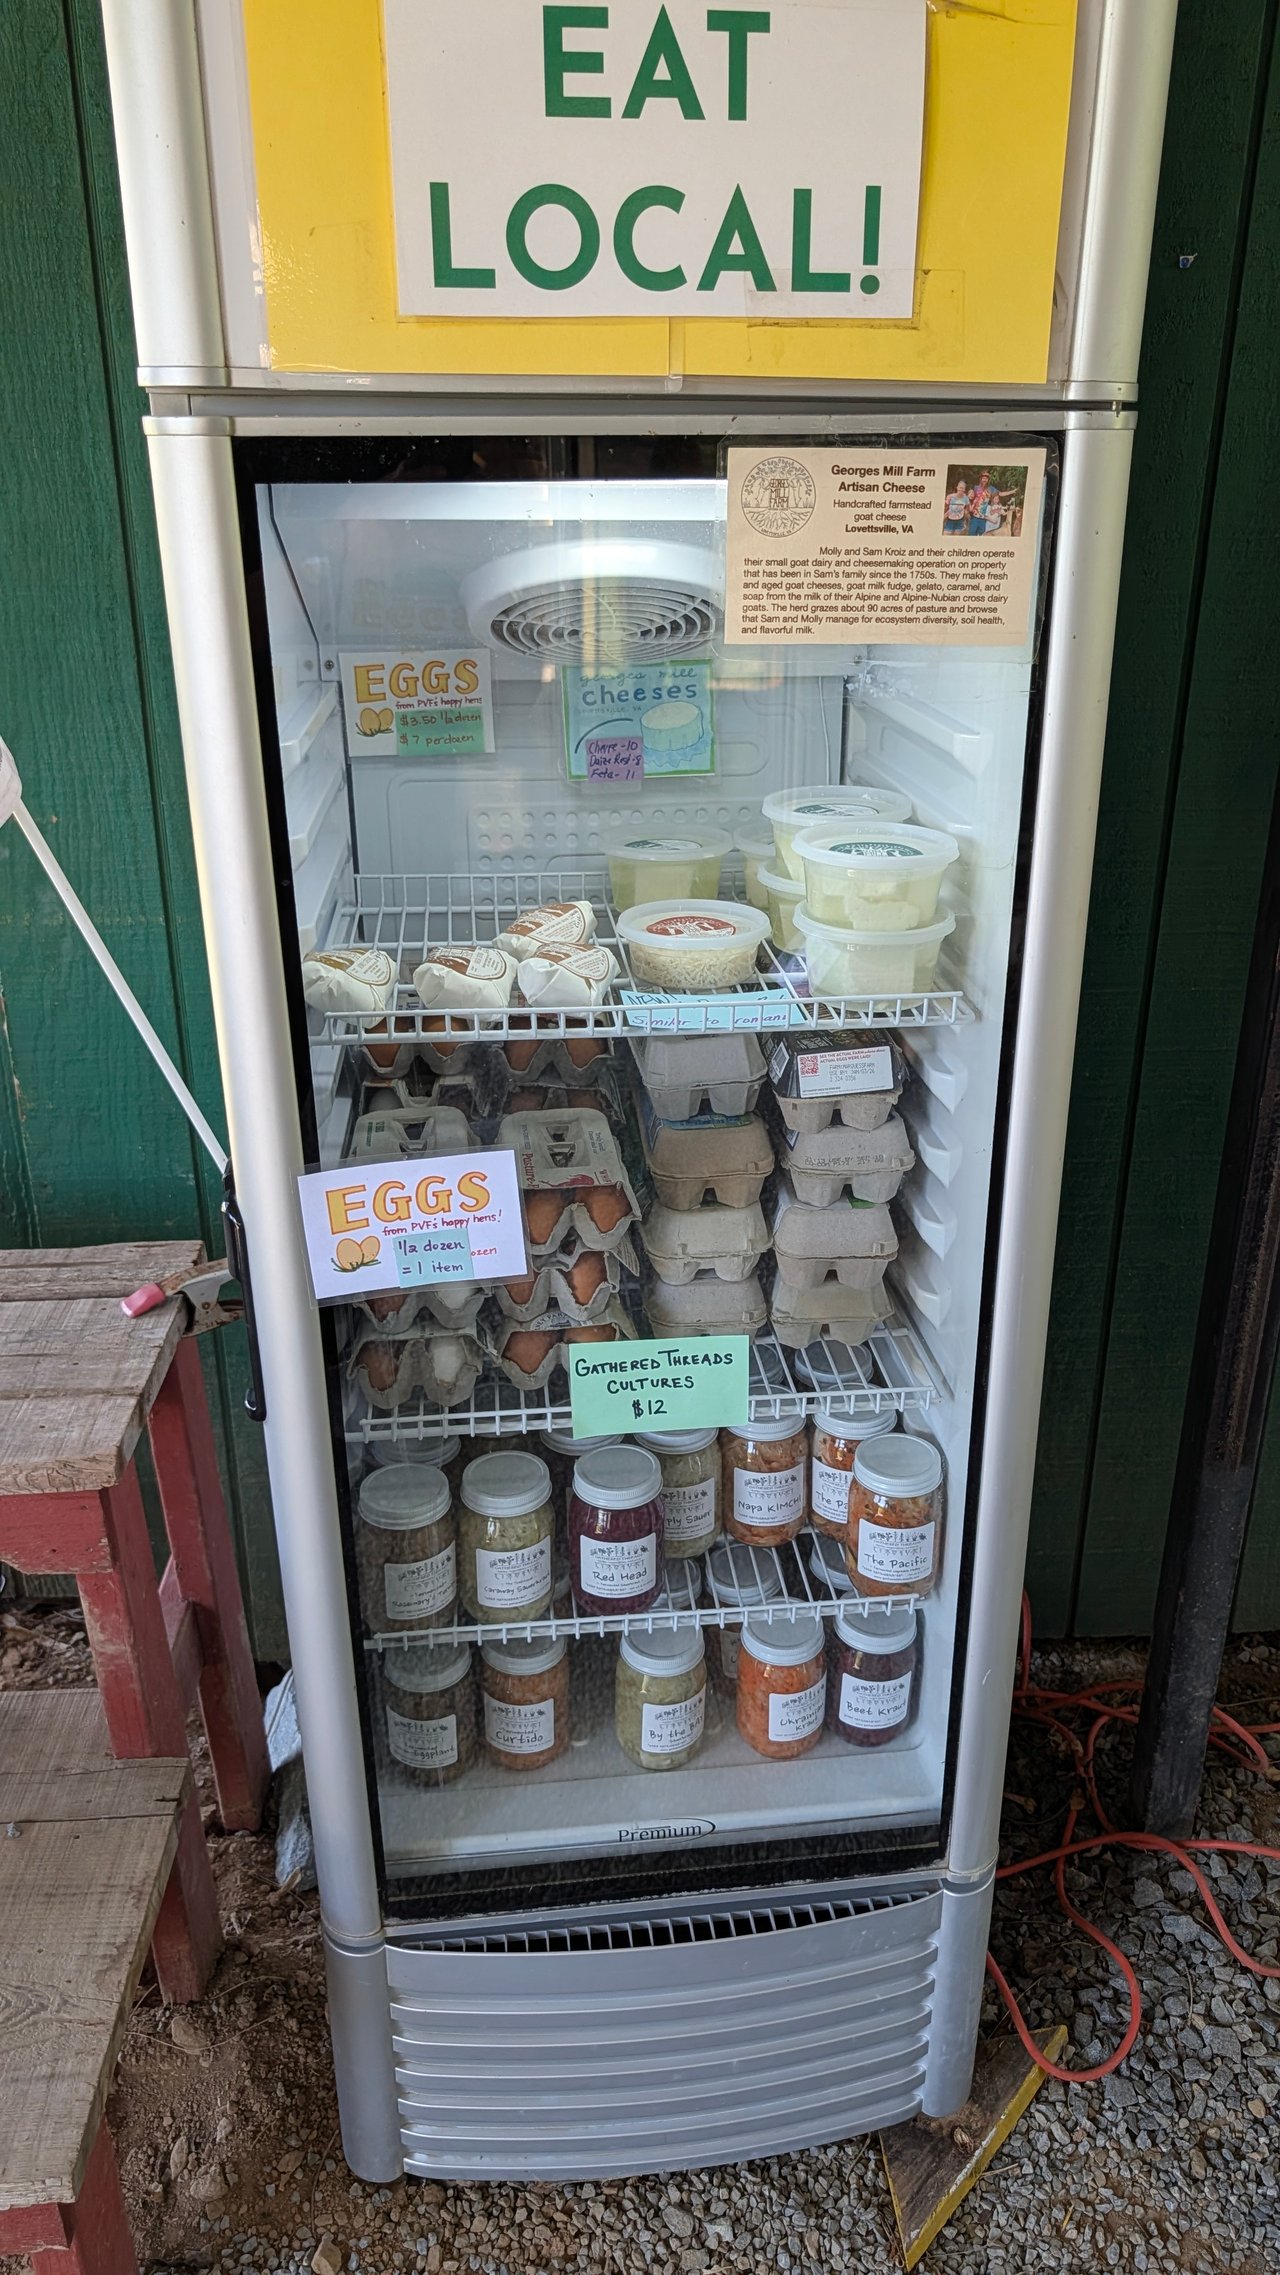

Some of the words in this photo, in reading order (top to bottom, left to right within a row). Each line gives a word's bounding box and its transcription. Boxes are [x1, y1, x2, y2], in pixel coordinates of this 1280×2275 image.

[543, 4, 770, 121] EAT
[429, 182, 882, 295] LOCAL!
[831, 465, 879, 478] Georges
[883, 466, 903, 476] Mill
[906, 466, 935, 477] Farm
[838, 482, 879, 492] Artisan
[882, 482, 925, 493] Cheese
[833, 499, 886, 508] Handcrafted
[889, 500, 932, 509] farmstead
[854, 513, 873, 522] goat
[876, 513, 906, 521] cheese
[845, 524, 899, 534] Lovettsville,
[901, 525, 914, 533] VA
[820, 547, 841, 557] Molly
[863, 548, 882, 556] Sam
[885, 548, 906, 556] Kroiz
[908, 548, 924, 556] and
[927, 549, 945, 557] their
[947, 549, 980, 557] children
[983, 550, 1015, 559] operate
[744, 558, 763, 566] their
[765, 558, 787, 567] small
[790, 559, 809, 568] goat
[812, 559, 832, 569] dairy
[835, 559, 851, 567] and
[853, 559, 913, 569] cheesemaking
[916, 560, 955, 569] operation
[971, 561, 1006, 570] property
[744, 569, 760, 577] that
[762, 569, 777, 578] has
[780, 570, 801, 578] been
[804, 570, 811, 578] in
[814, 569, 839, 578] Sam's
[842, 570, 867, 580] family
[869, 570, 891, 578] since
[894, 571, 907, 579] the
[910, 571, 937, 579] 1750s.
[940, 571, 960, 581] They
[963, 572, 985, 580] make
[988, 572, 1008, 580] fresh
[743, 581, 759, 589] and
[762, 581, 782, 591] aged
[785, 581, 804, 591] goat
[807, 581, 844, 591] cheeses,
[847, 582, 865, 591] goat
[868, 582, 885, 590] milk
[888, 582, 913, 592] fudge,
[916, 583, 944, 592] gelato,
[947, 583, 982, 592] caramel,
[985, 583, 1000, 591] and
[743, 593, 763, 601] soap
[766, 592, 785, 600] from
[855, 593, 881, 602] Alpine
[884, 593, 899, 601] and
[901, 593, 960, 603] Alpine-Nubian
[988, 594, 1008, 604] dairy
[742, 604, 768, 613] goats.
[771, 603, 787, 611] The
[790, 604, 808, 612] herd
[811, 605, 838, 613] grazes
[841, 604, 864, 612] about
[868, 604, 878, 612] 90
[905, 604, 914, 612] of
[916, 605, 947, 614] pasture
[949, 605, 965, 613] and
[967, 605, 997, 613] browse
[783, 615, 798, 623] and
[801, 615, 823, 625] Molly
[826, 616, 859, 625] manage
[862, 615, 872, 623] for
[875, 616, 920, 625] ecosystem
[923, 616, 958, 625] diversity,
[961, 616, 975, 624] soil
[977, 616, 1005, 625] health,
[741, 626, 757, 634] and
[760, 626, 793, 634] flavorful
[796, 626, 815, 634] milk.
[353, 659, 479, 704] EGGS
[582, 684, 697, 706] cheeses
[395, 701, 414, 710] from
[417, 697, 438, 707] PVF's
[441, 697, 462, 708] happy
[400, 714, 437, 727] $3.50
[400, 735, 408, 746] $
[412, 735, 419, 744] 7
[325, 1171, 491, 1235] EGGS
[382, 1226, 407, 1236] from
[411, 1218, 437, 1232] PVF's
[441, 1218, 469, 1231] happy
[473, 1209, 502, 1224] hens!
[423, 1240, 465, 1251] dozen
[470, 1247, 497, 1257] ozen
[432, 1261, 464, 1272] item
[575, 1358, 660, 1377] GATHERED
[658, 1349, 733, 1367] THREADS
[607, 1376, 694, 1394] CULTURES
[632, 1399, 667, 1419] $12
[816, 1491, 831, 1504] The
[738, 1500, 762, 1513] Napa
[864, 1553, 884, 1566] The
[889, 1556, 928, 1568] Pacific
[592, 1571, 615, 1581] Red
[620, 1567, 647, 1580] Head
[484, 1586, 515, 1595] Caraway
[847, 1701, 872, 1715] Beet
[496, 1731, 543, 1743] Curtido
[649, 1729, 663, 1742] By
[668, 1729, 685, 1738] the
[617, 1825, 701, 1842] Premium
